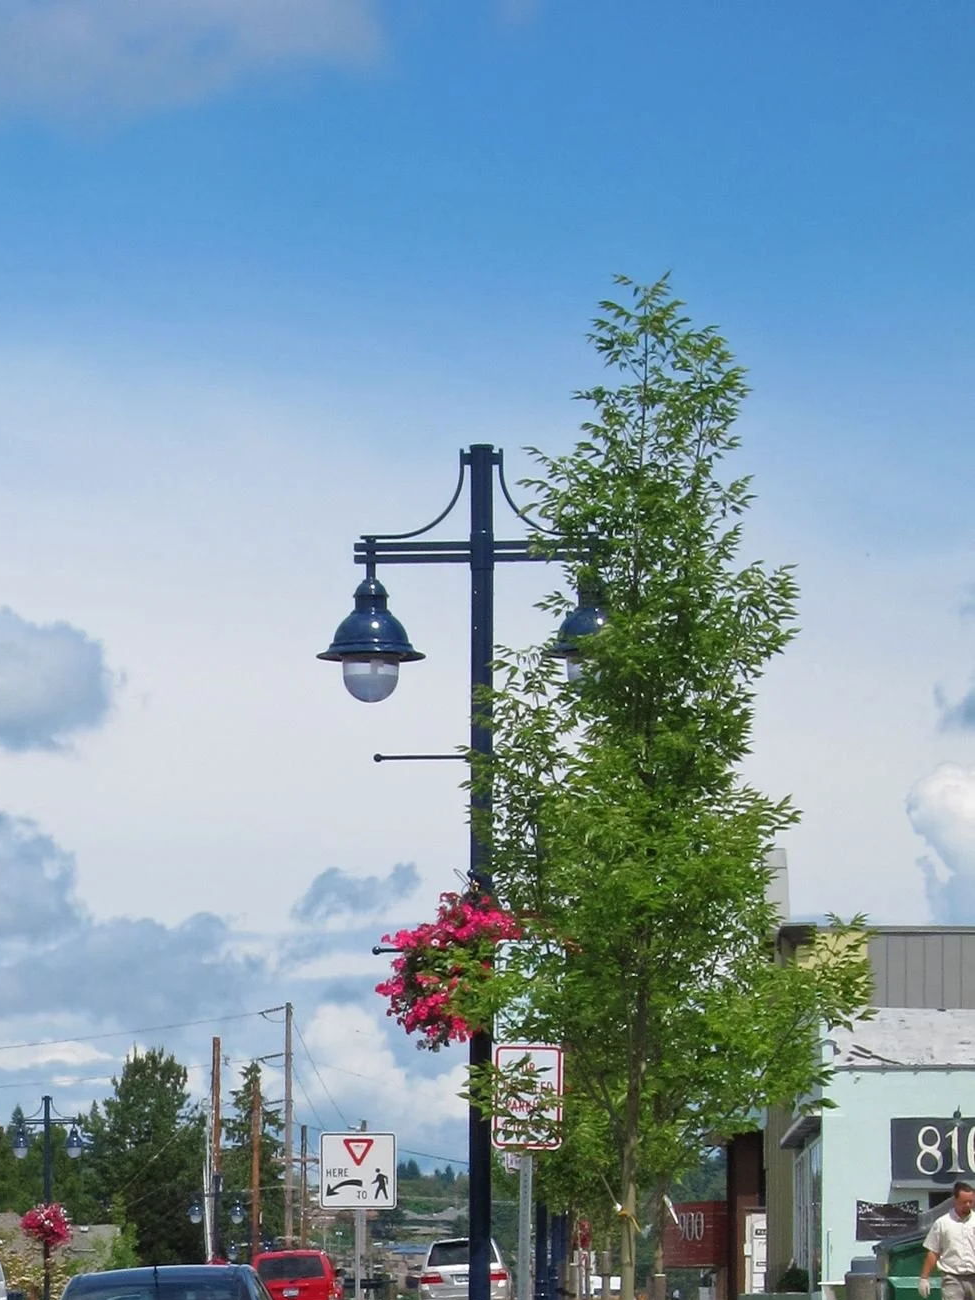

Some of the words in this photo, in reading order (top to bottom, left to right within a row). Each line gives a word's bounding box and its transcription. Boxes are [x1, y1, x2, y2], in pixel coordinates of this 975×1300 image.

[505, 1098, 550, 1113] PARK
[325, 1167, 349, 1178] HERE
[356, 1190, 367, 1200] TO
